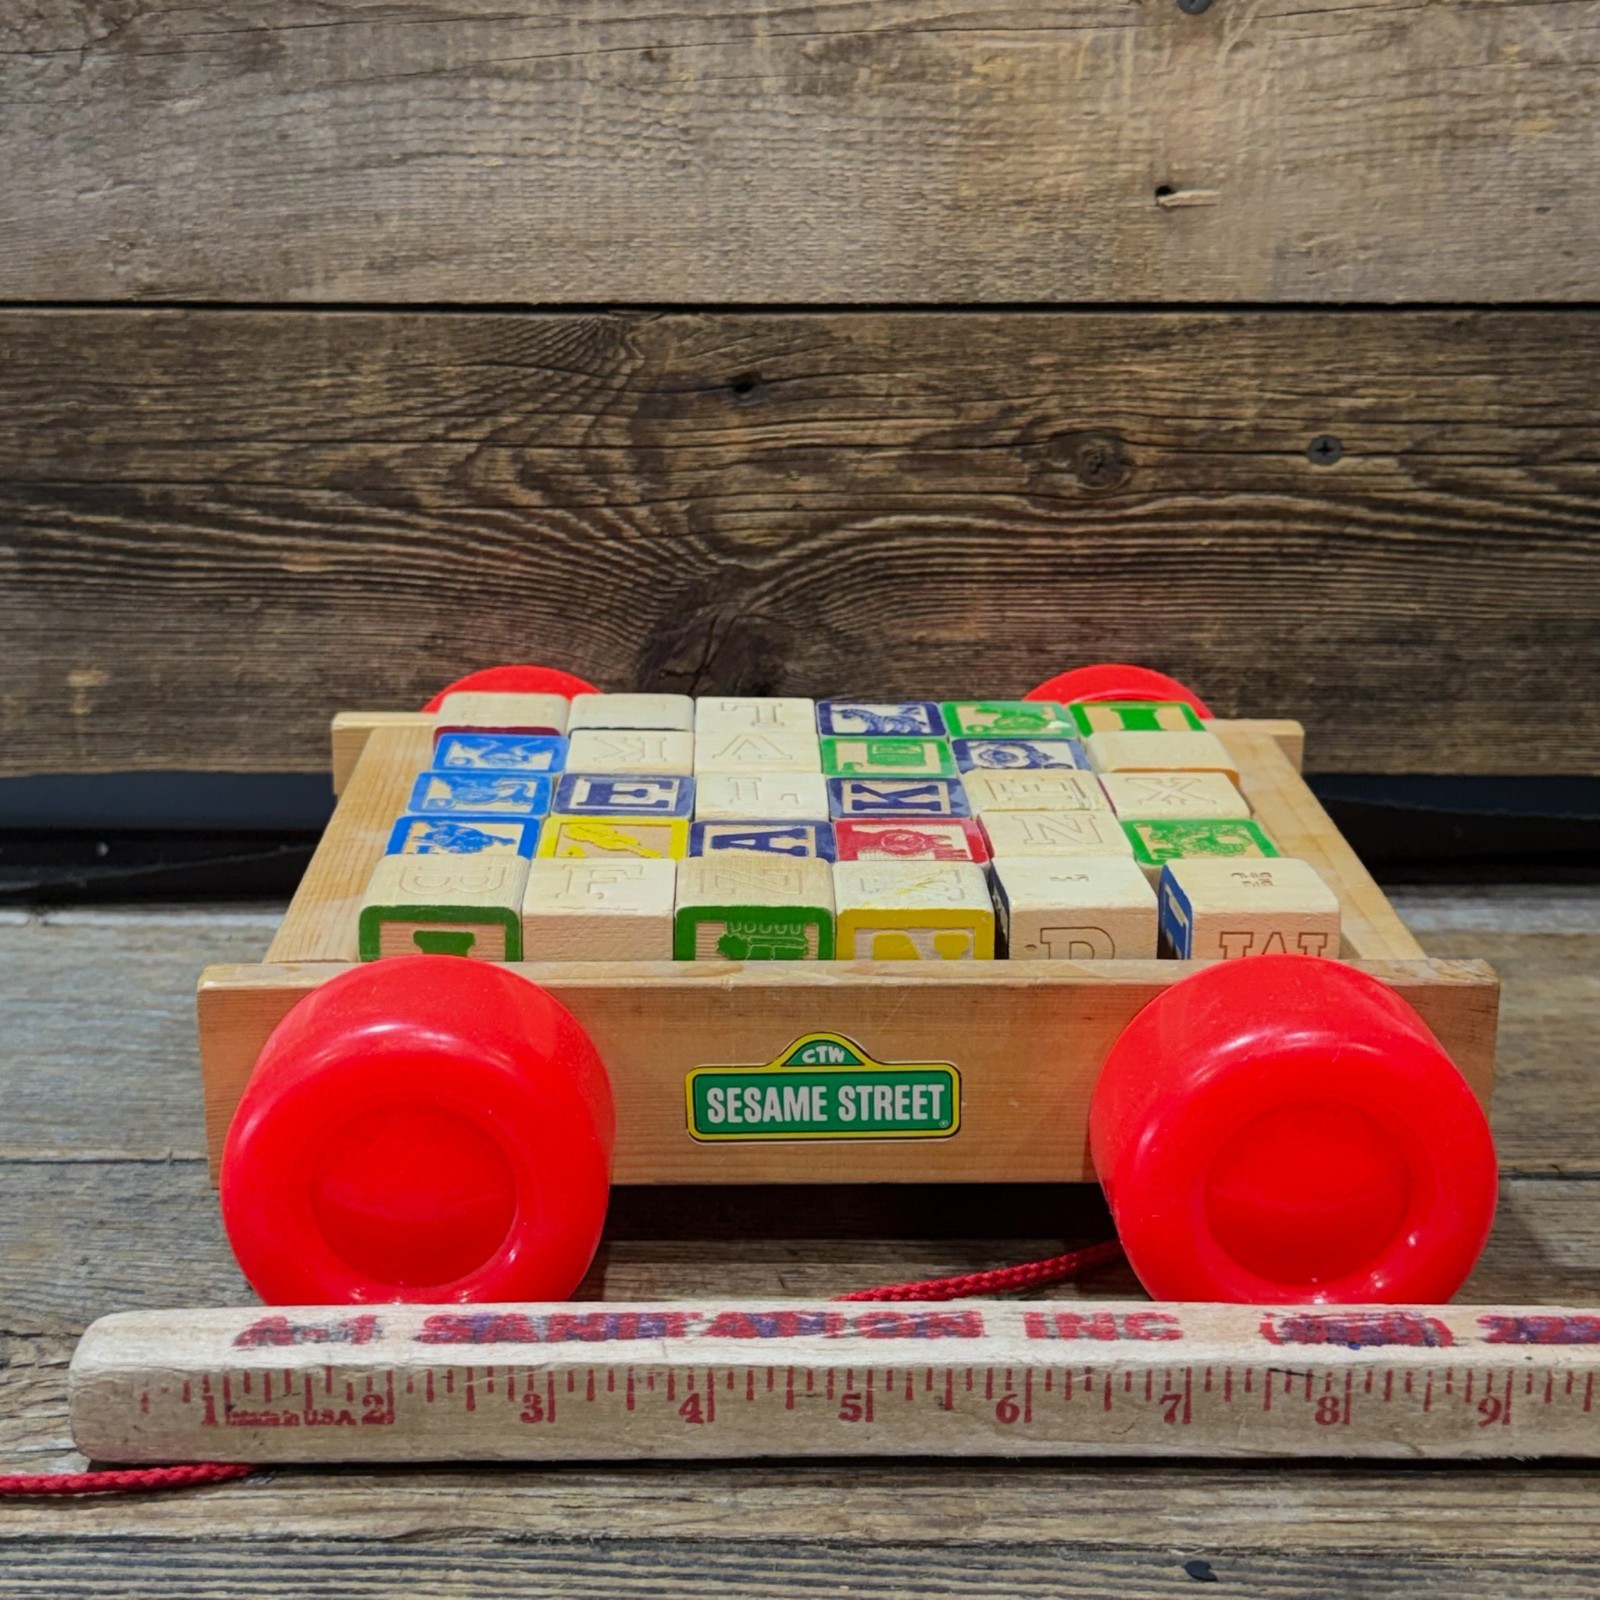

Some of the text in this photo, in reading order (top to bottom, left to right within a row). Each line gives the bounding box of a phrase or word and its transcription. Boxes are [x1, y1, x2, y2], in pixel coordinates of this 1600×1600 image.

[576, 777, 674, 809] E
[851, 784, 941, 812] K
[1125, 777, 1217, 805] X
[712, 827, 808, 857] A
[1012, 814, 1104, 845] N
[554, 864, 645, 900] F
[801, 1046, 846, 1064] CTW
[706, 1084, 945, 1123] SESAME STREET
[418, 1311, 985, 1343] SANITATION
[1024, 1311, 1184, 1341] INC
[362, 1394, 385, 1425] 2
[520, 1393, 544, 1424] 3
[678, 1393, 705, 1424] 4
[838, 1393, 863, 1424] 5
[995, 1396, 1020, 1425] 6
[1160, 1396, 1182, 1425] 7
[1315, 1396, 1340, 1425] 8
[1478, 1396, 1502, 1425] 9
